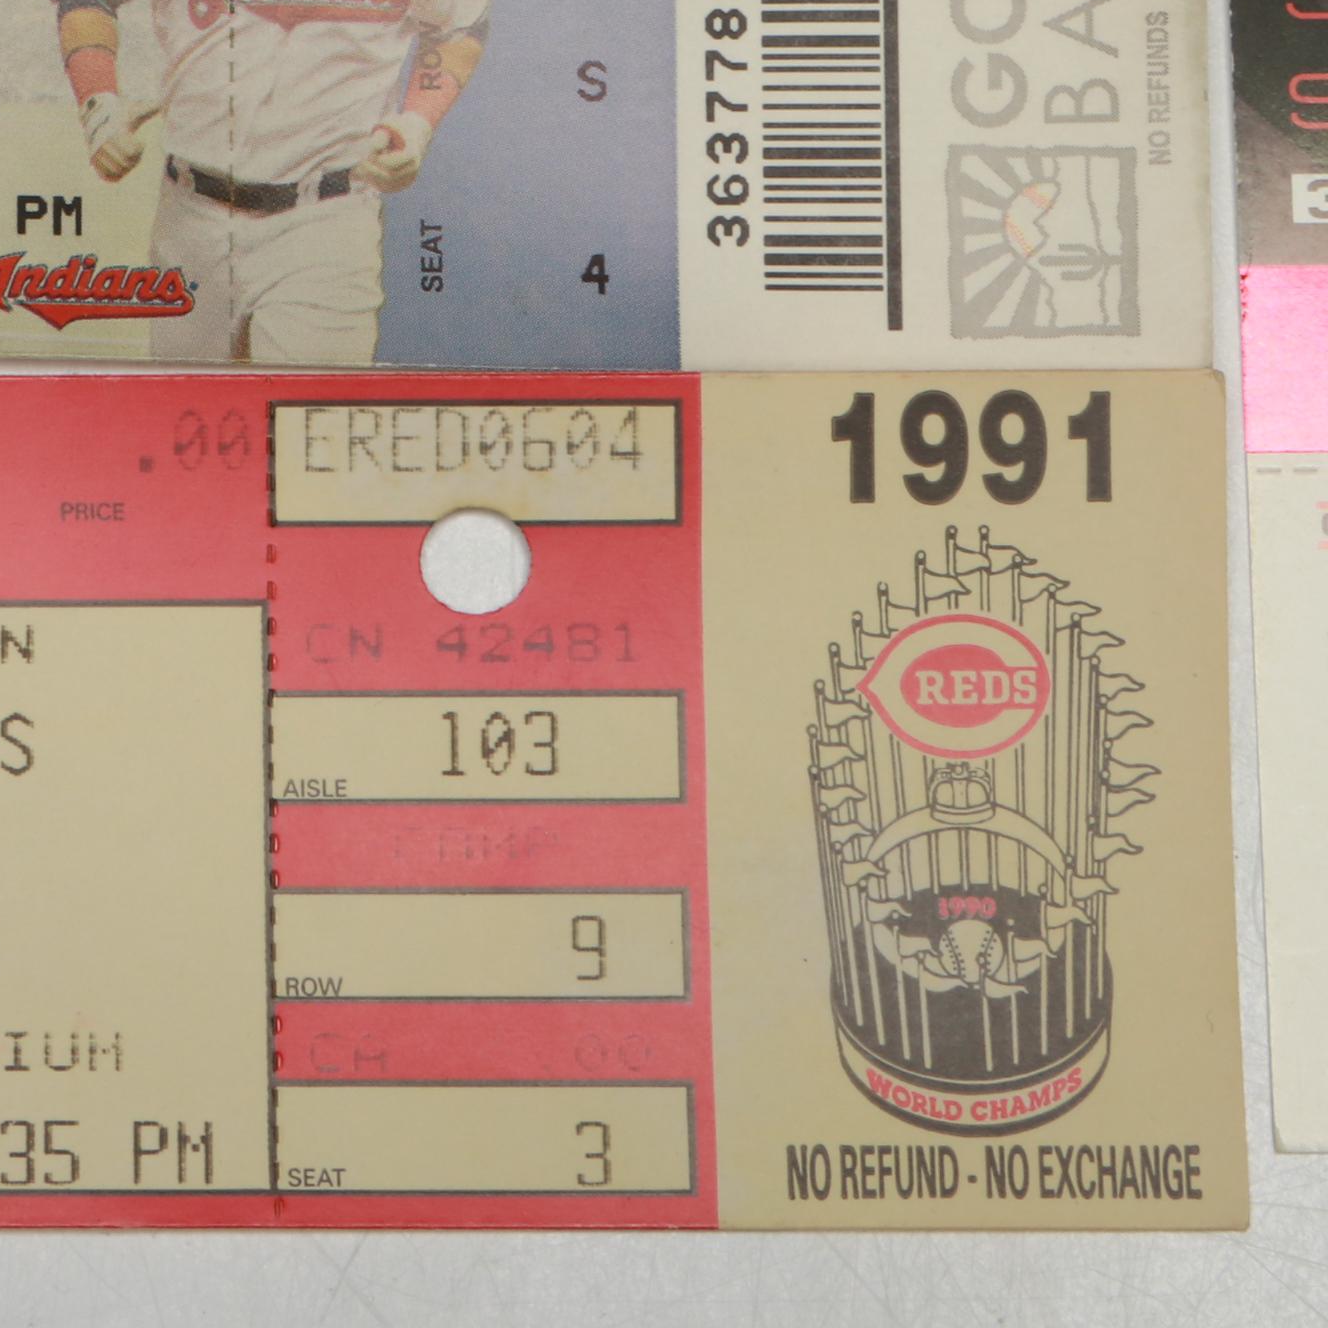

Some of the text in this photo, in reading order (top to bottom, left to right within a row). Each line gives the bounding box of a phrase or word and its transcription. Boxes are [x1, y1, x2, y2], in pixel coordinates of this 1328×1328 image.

[421, 21, 443, 90] ROW
[1145, 10, 1171, 125] REFUNDS
[577, 60, 608, 102] S
[1149, 130, 1172, 165] NO
[17, 195, 84, 236] PM
[421, 219, 444, 292] SEAT
[580, 254, 610, 295] 4
[305, 407, 643, 472] ERED0604
[831, 390, 1112, 505] 1991
[60, 503, 125, 521] PRICE
[306, 624, 637, 662] CN 42481
[917, 670, 1037, 705] REDS
[442, 711, 558, 776] 103
[283, 780, 347, 797] AISLE
[938, 896, 996, 917] 1990
[572, 915, 605, 980] 9
[285, 978, 343, 997] ROW
[866, 1067, 1082, 1121] WORLD CHAMPS
[134, 1120, 214, 1184] PM
[576, 1121, 610, 1186] 3
[786, 1144, 1202, 1200] NO REFUND NO EXCHANGE
[288, 1169, 345, 1187] SEAT
